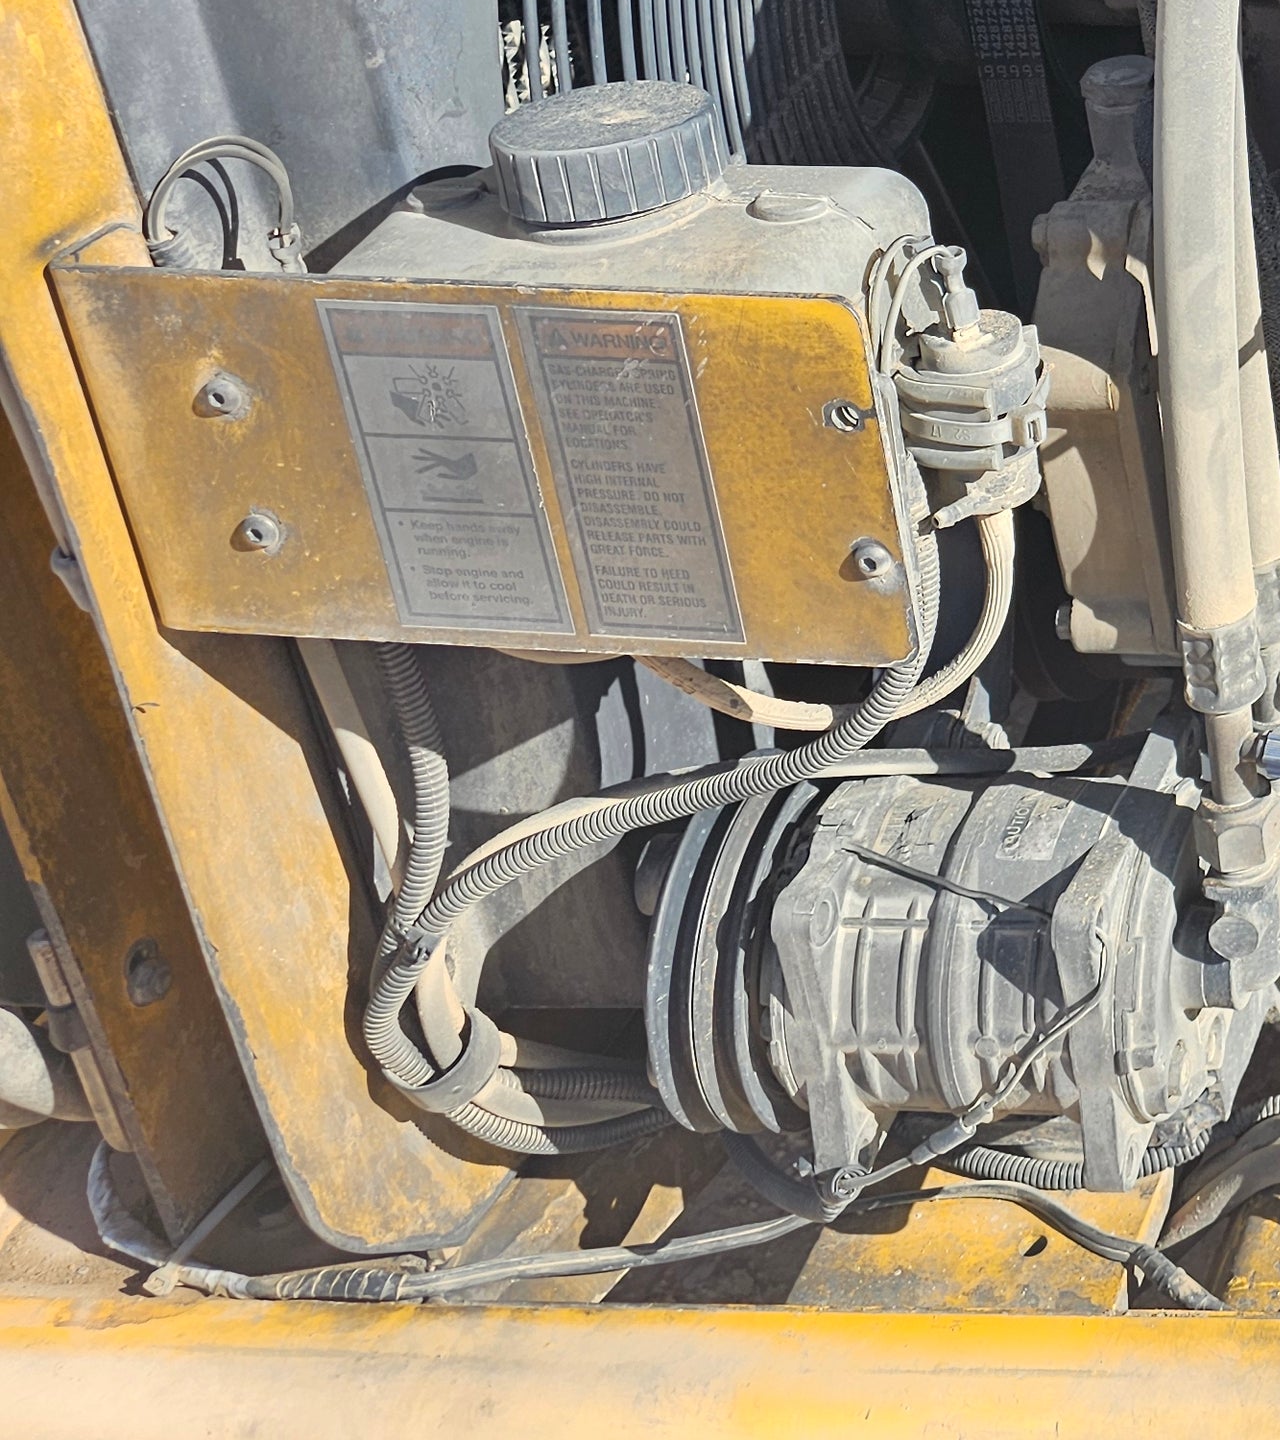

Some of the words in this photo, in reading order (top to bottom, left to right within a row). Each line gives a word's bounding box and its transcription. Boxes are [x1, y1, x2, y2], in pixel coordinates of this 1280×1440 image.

[571, 330, 667, 351] WARNING
[645, 383, 674, 394] USED
[577, 395, 600, 406] THIS
[571, 459, 633, 473] CYLINDERS
[636, 462, 666, 474] HAVE
[574, 475, 601, 485] HIGH
[605, 476, 660, 488] INTERNAL
[644, 491, 660, 502] DO
[663, 493, 686, 503] NOT
[410, 519, 443, 532] Keep
[663, 520, 701, 532] COULD
[414, 533, 448, 544] when
[451, 536, 494, 548] engine
[587, 530, 636, 543] RELEASE
[639, 533, 674, 545] PARTS
[677, 535, 707, 546] WITH
[418, 546, 471, 559] running.
[590, 545, 626, 556] GREAT
[629, 547, 670, 558] FORCE.
[422, 564, 453, 577] Stop
[456, 567, 497, 578] engine
[501, 568, 524, 579] and
[595, 565, 641, 578] FAILURE
[645, 567, 658, 579] TO
[661, 568, 690, 581] HEED
[426, 577, 459, 589] allow
[473, 580, 486, 590] to
[489, 580, 517, 591] cool
[599, 578, 636, 591] COULD
[638, 580, 680, 593] RESULT
[683, 583, 695, 593] IN
[428, 589, 469, 602] before
[472, 594, 534, 605] servicing.
[601, 593, 637, 604] DEATH
[640, 595, 655, 606] OR
[658, 596, 707, 609] SERIOUS
[604, 606, 647, 619] INJURY.
